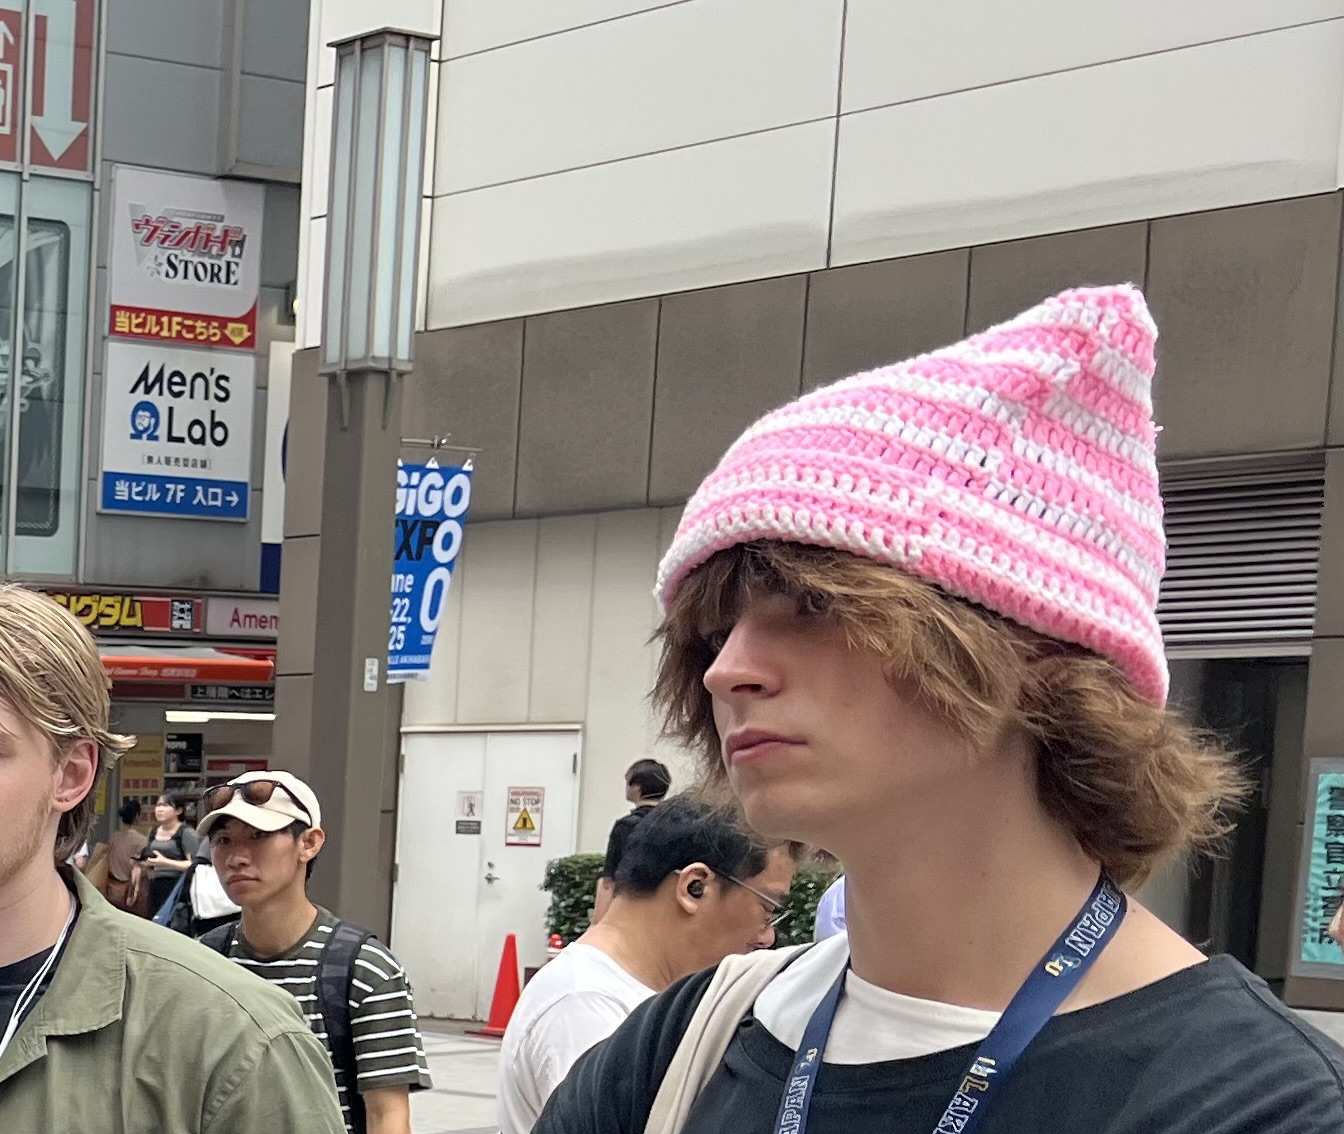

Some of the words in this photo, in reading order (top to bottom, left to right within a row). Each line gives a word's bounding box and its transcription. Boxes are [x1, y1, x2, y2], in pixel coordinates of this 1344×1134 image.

[165, 252, 239, 286] STORE
[115, 310, 222, 342] 当ビル1Fこちら
[129, 360, 231, 403] Men's
[167, 406, 229, 447] Lab
[114, 480, 161, 502] 当ビル
[165, 483, 186, 504] 7F
[192, 486, 223, 508] 入口
[394, 519, 462, 564] XPO
[388, 624, 405, 650] 25
[1064, 881, 1123, 957] APAN
